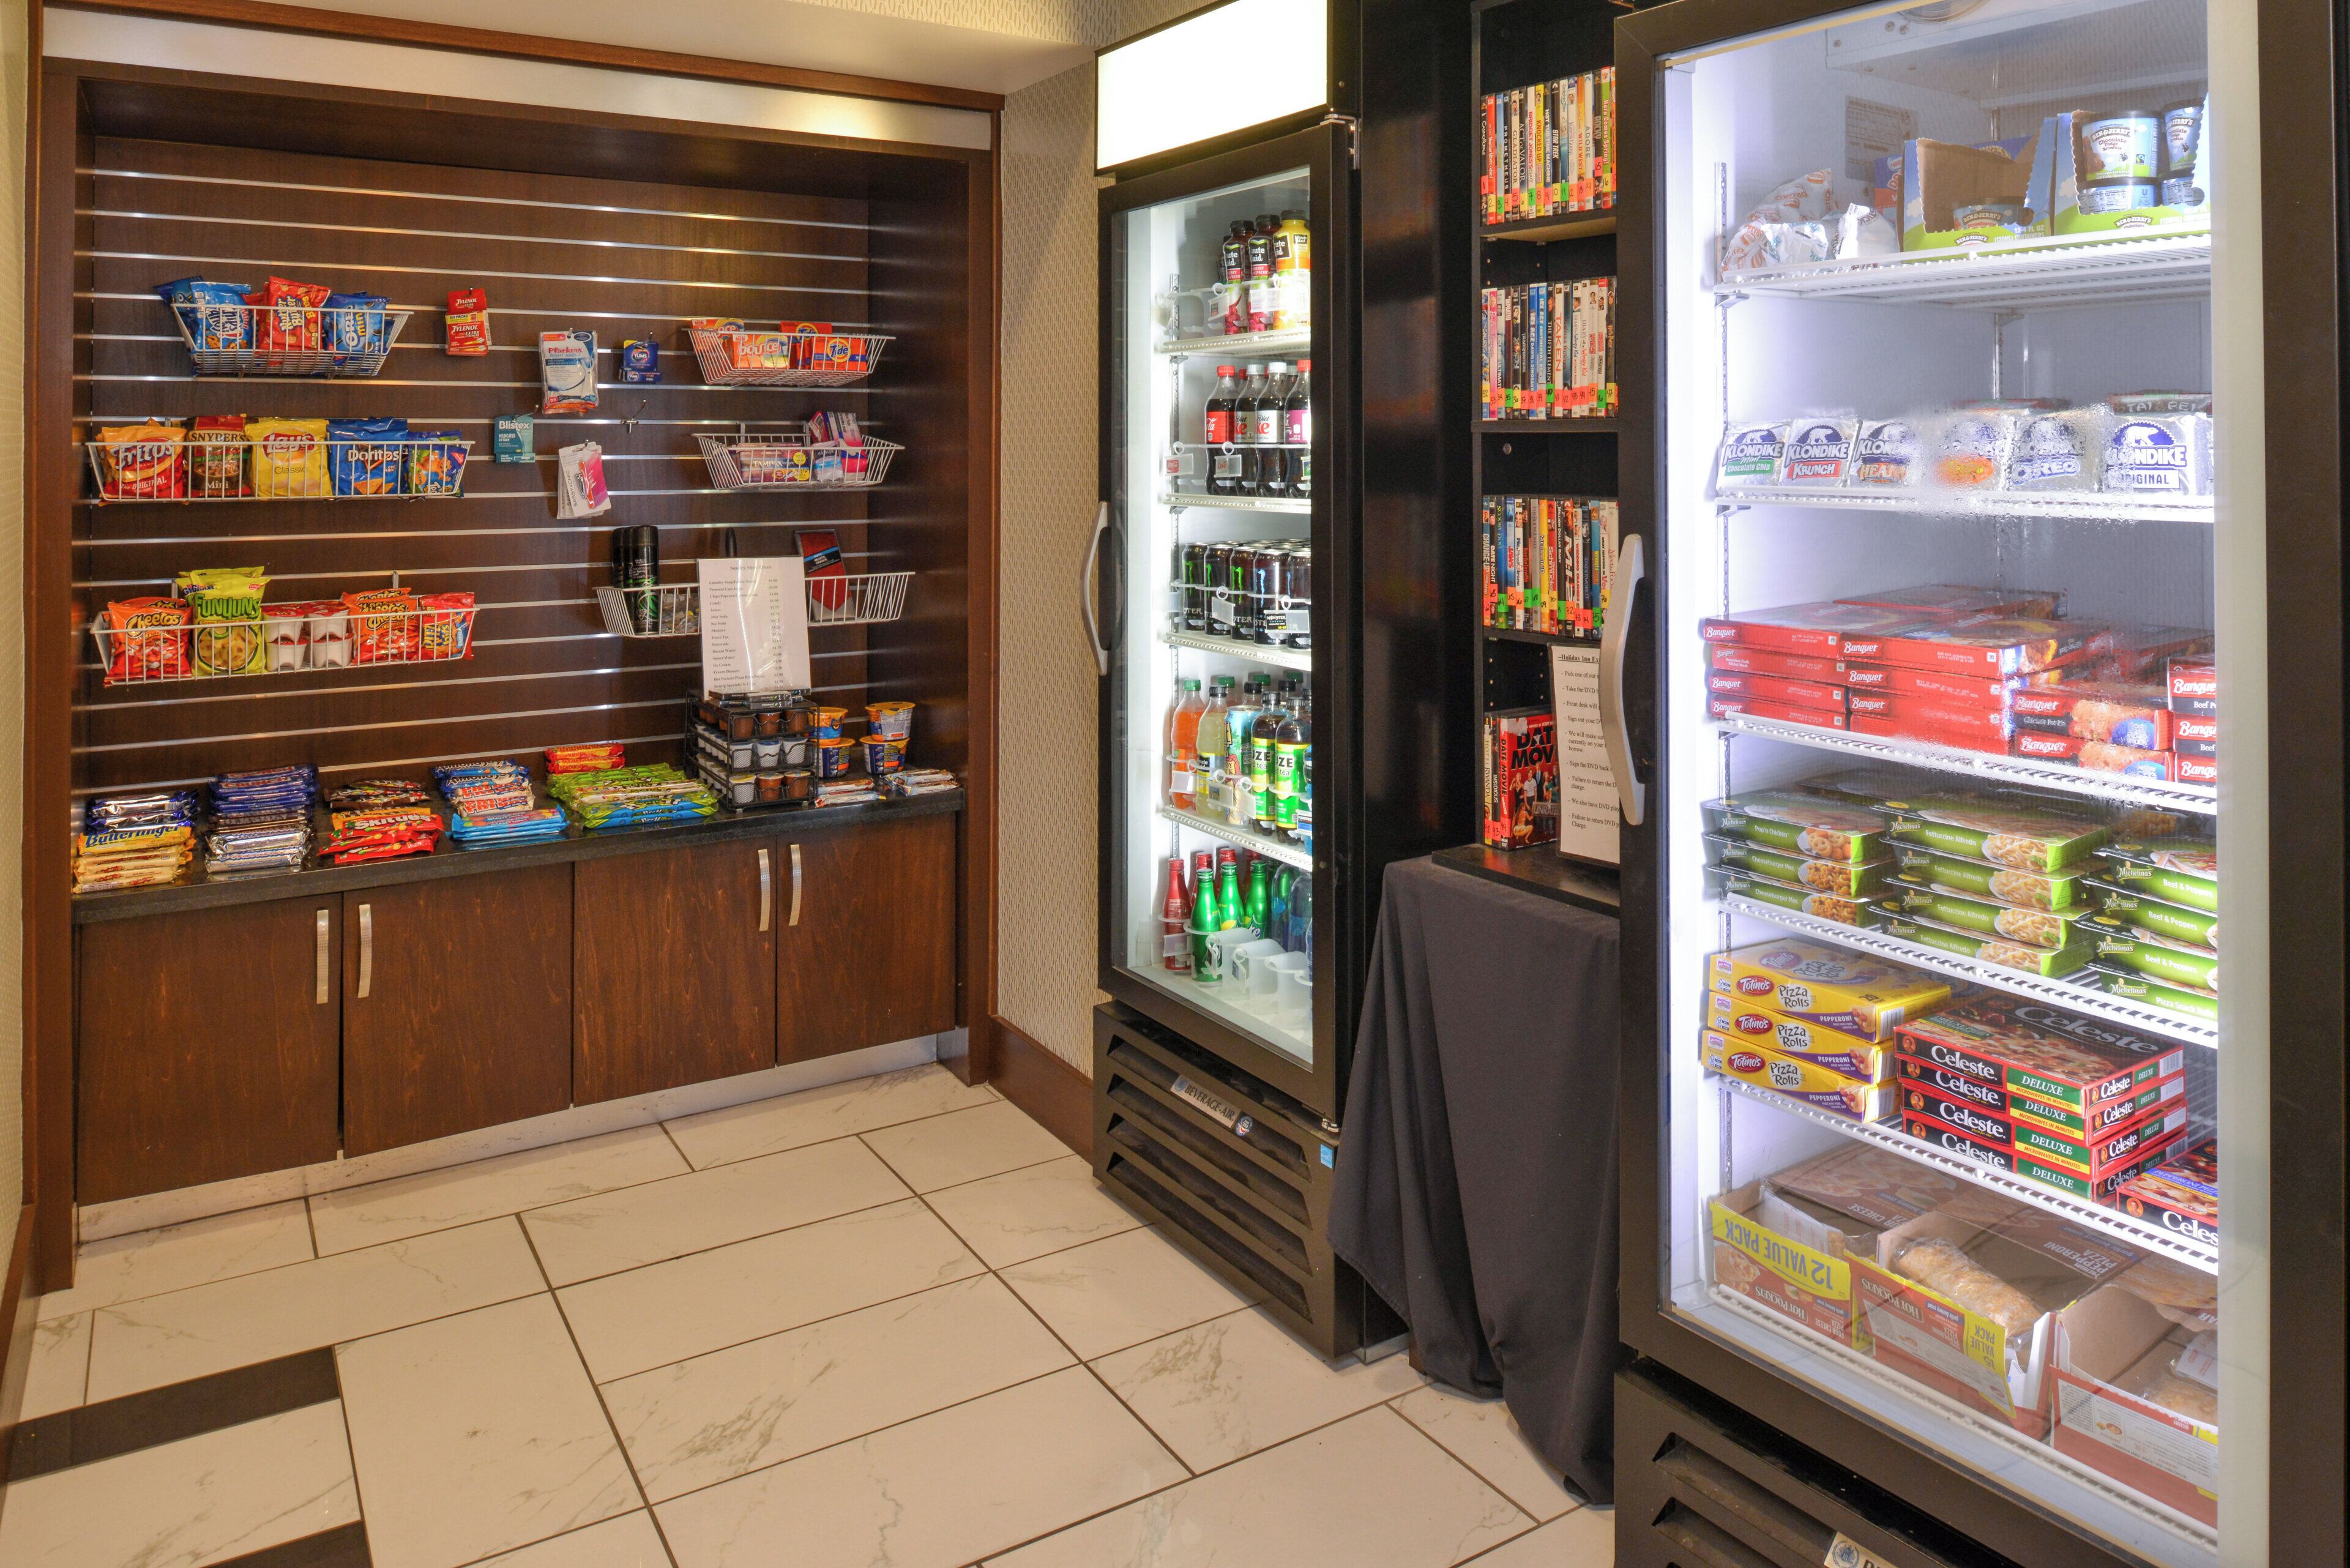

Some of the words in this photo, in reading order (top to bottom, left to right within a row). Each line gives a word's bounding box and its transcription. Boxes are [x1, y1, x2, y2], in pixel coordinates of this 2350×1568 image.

[2098, 137, 2127, 146] Chocolate
[1537, 152, 1542, 162] UP
[345, 305, 358, 346] OREO
[451, 325, 479, 334] TYLENOL
[738, 342, 780, 355] bounce
[830, 344, 848, 357] Tide
[191, 432, 245, 442] SNYDER'S
[110, 439, 174, 469] Fritos
[348, 450, 400, 461] Doritos
[1723, 442, 1784, 466] KLONDIKE
[1785, 442, 1849, 467] KLONDIKE
[1792, 463, 1835, 480] KRUNCH
[125, 612, 182, 638] Cheetos
[1707, 627, 1736, 638] Banquet
[1843, 642, 1879, 654] Banquet
[1712, 678, 1742, 689] Banquet
[1849, 671, 1884, 683] Banquet
[1713, 702, 1743, 713] Banquet
[1852, 698, 1886, 711] Banquet
[354, 813, 431, 830] Skittles
[1769, 829, 1788, 838] Chicken
[1926, 830, 1954, 842] Fettuccine
[1955, 836, 1977, 846] Alfredo
[1752, 856, 1783, 869] Cheeseburger
[2118, 867, 2152, 879] Michelina's
[2163, 879, 2177, 889] Beef
[2186, 884, 2214, 897] Peppers
[2149, 911, 2163, 921] Beef
[2171, 917, 2198, 931] Peppers
[2097, 941, 2134, 952] Michelina's
[1740, 977, 1770, 991] Totino's
[2109, 984, 2147, 995] Michelina's
[1777, 985, 1808, 998] Pizza
[1784, 996, 1810, 1009] Rolls
[1739, 1015, 1769, 1030] Totino's
[1775, 1025, 1806, 1037] Pizza
[1781, 1036, 1808, 1048] Rolls
[1731, 1055, 1761, 1068] Totino's
[1768, 1062, 1797, 1075] Pizza
[2138, 1067, 2154, 1081] DELUXE
[1775, 1074, 1799, 1087] Rolls
[2021, 1075, 2064, 1096] DELUXE
[2016, 1087, 2046, 1100] MICROWAVES
[2052, 1098, 2072, 1110] MINUTES
[2026, 1101, 2067, 1122] DELUXE
[2031, 1133, 2072, 1155] DELUXE
[2032, 1167, 2074, 1189] DELUXE
[2162, 1210, 2218, 1246] Celes
[1725, 1219, 1759, 1254] PACK
[1763, 1236, 1807, 1277] VALUE
[1975, 1324, 1995, 1344] PACK
[1970, 1337, 1995, 1357] VALUE
